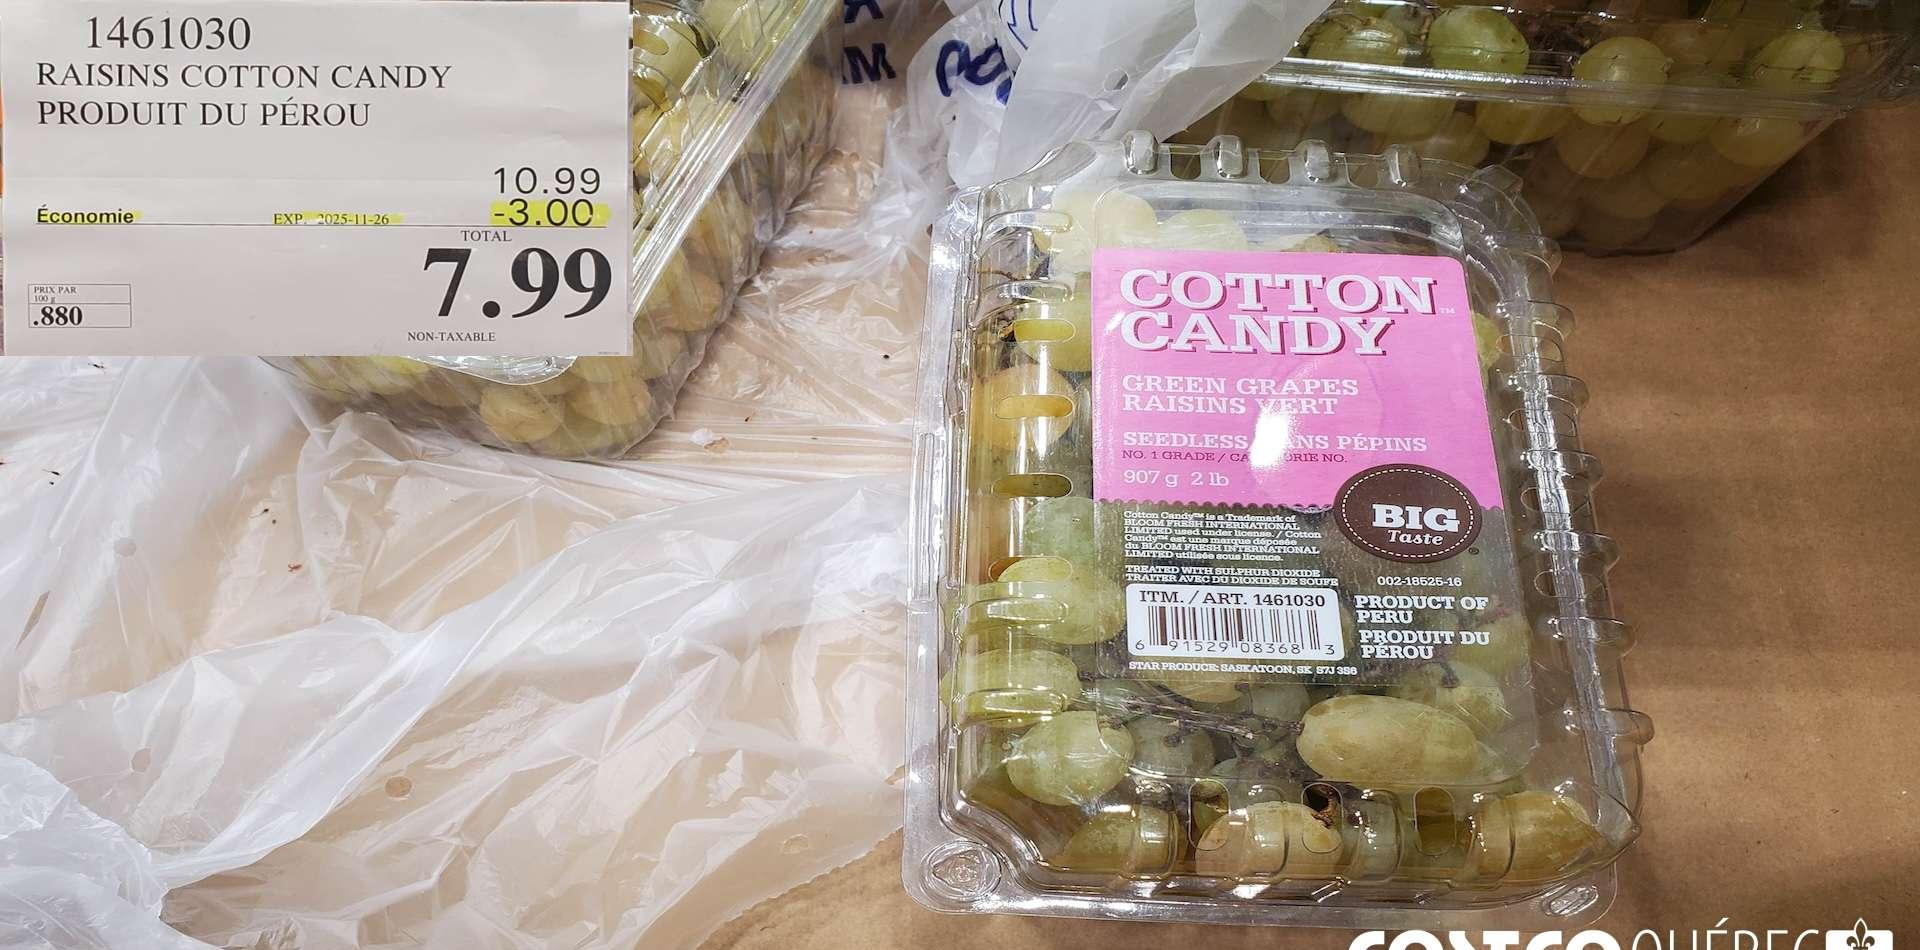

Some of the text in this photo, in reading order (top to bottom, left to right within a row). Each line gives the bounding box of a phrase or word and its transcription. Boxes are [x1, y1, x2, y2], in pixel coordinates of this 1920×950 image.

[87, 16, 251, 50] 1461030
[37, 63, 452, 88] RAISINS COTTON CANDY
[37, 97, 371, 126] PRODUIT DU PÉROU
[494, 167, 601, 194] 10.99
[37, 205, 390, 225] Économie EXP. 2025-11-26
[494, 199, 594, 226] -3.00
[461, 231, 512, 241] TOTAL
[424, 247, 612, 318] 7.99
[1120, 269, 1438, 314] COTTON
[34, 306, 82, 326] .880
[408, 332, 496, 342] NON-TAXABLE
[1120, 310, 1395, 356] CANDY
[1122, 375, 1359, 395] GREEN GRAPES
[1122, 395, 1338, 415] RAISINS VERT
[1122, 432, 1248, 449] SEEDLESS
[1335, 433, 1427, 452] PÉPINS
[1122, 450, 1145, 460] NO.
[1151, 451, 1158, 461] 1
[1161, 451, 1215, 461] GRADE
[1217, 452, 1226, 462] /
[1321, 454, 1347, 463] NO.
[1123, 470, 1229, 487] 907 g 2 lb
[1124, 511, 1159, 519] Cotton
[1206, 512, 1216, 520] is
[1225, 514, 1284, 522] Trademark
[1371, 504, 1460, 532] BIG
[1124, 519, 1300, 530] BLOOM FRESH INTERNATIONAL
[1124, 526, 1172, 534] LIMITED
[1201, 529, 1233, 537] under
[1234, 530, 1275, 538] license.
[1210, 538, 1251, 546] marque
[1253, 538, 1298, 546] déposée
[1388, 530, 1443, 545] Taste
[1125, 550, 1174, 558] LIMITED
[1243, 553, 1284, 561] licence.
[1141, 543, 1183, 551] BLOOM
[1223, 545, 1320, 554] INTERNATIONAL
[1125, 565, 1321, 577] TREATED WITH SULPHUR DIOXIDE
[1125, 574, 1177, 582] TRAITER
[1178, 575, 1211, 583] AVEC
[1211, 576, 1229, 584] DU
[1231, 577, 1280, 585] DIOXIDE
[1139, 591, 1326, 607] ITM. / ART. 1461030
[1354, 595, 1489, 610] PRODUCT OF
[1356, 610, 1413, 624] PERU
[1359, 630, 1490, 645] PRODUIT DU
[1135, 640, 1336, 655] 6 91529 08368 3
[1361, 641, 1434, 659] PÉROU
[1128, 661, 1160, 670] STAR
[1220, 664, 1296, 674] SASKATOON,
[1296, 666, 1313, 674] SK
